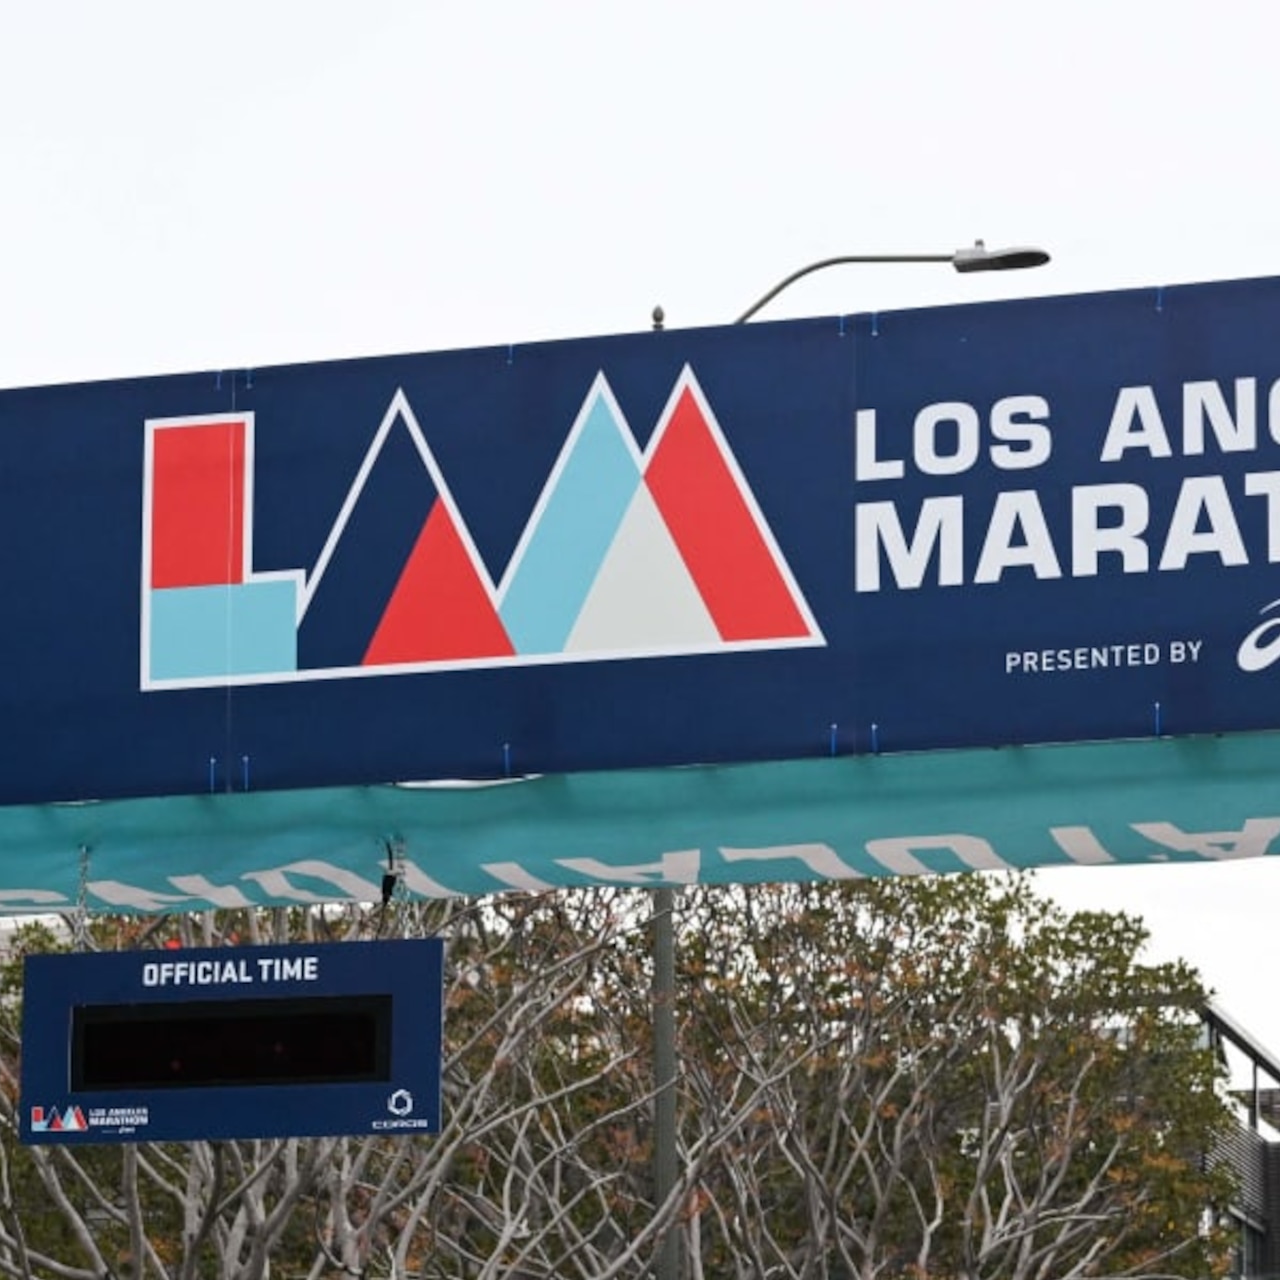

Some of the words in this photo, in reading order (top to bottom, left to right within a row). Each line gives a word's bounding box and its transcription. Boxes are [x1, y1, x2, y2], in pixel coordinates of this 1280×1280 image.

[854, 395, 1052, 482] LOS
[1005, 642, 1162, 674] PRESENTED
[1170, 640, 1203, 666] BY
[143, 960, 252, 987] OFFICIAL
[258, 957, 319, 982] TIME
[89, 1114, 149, 1126] MARATHON
